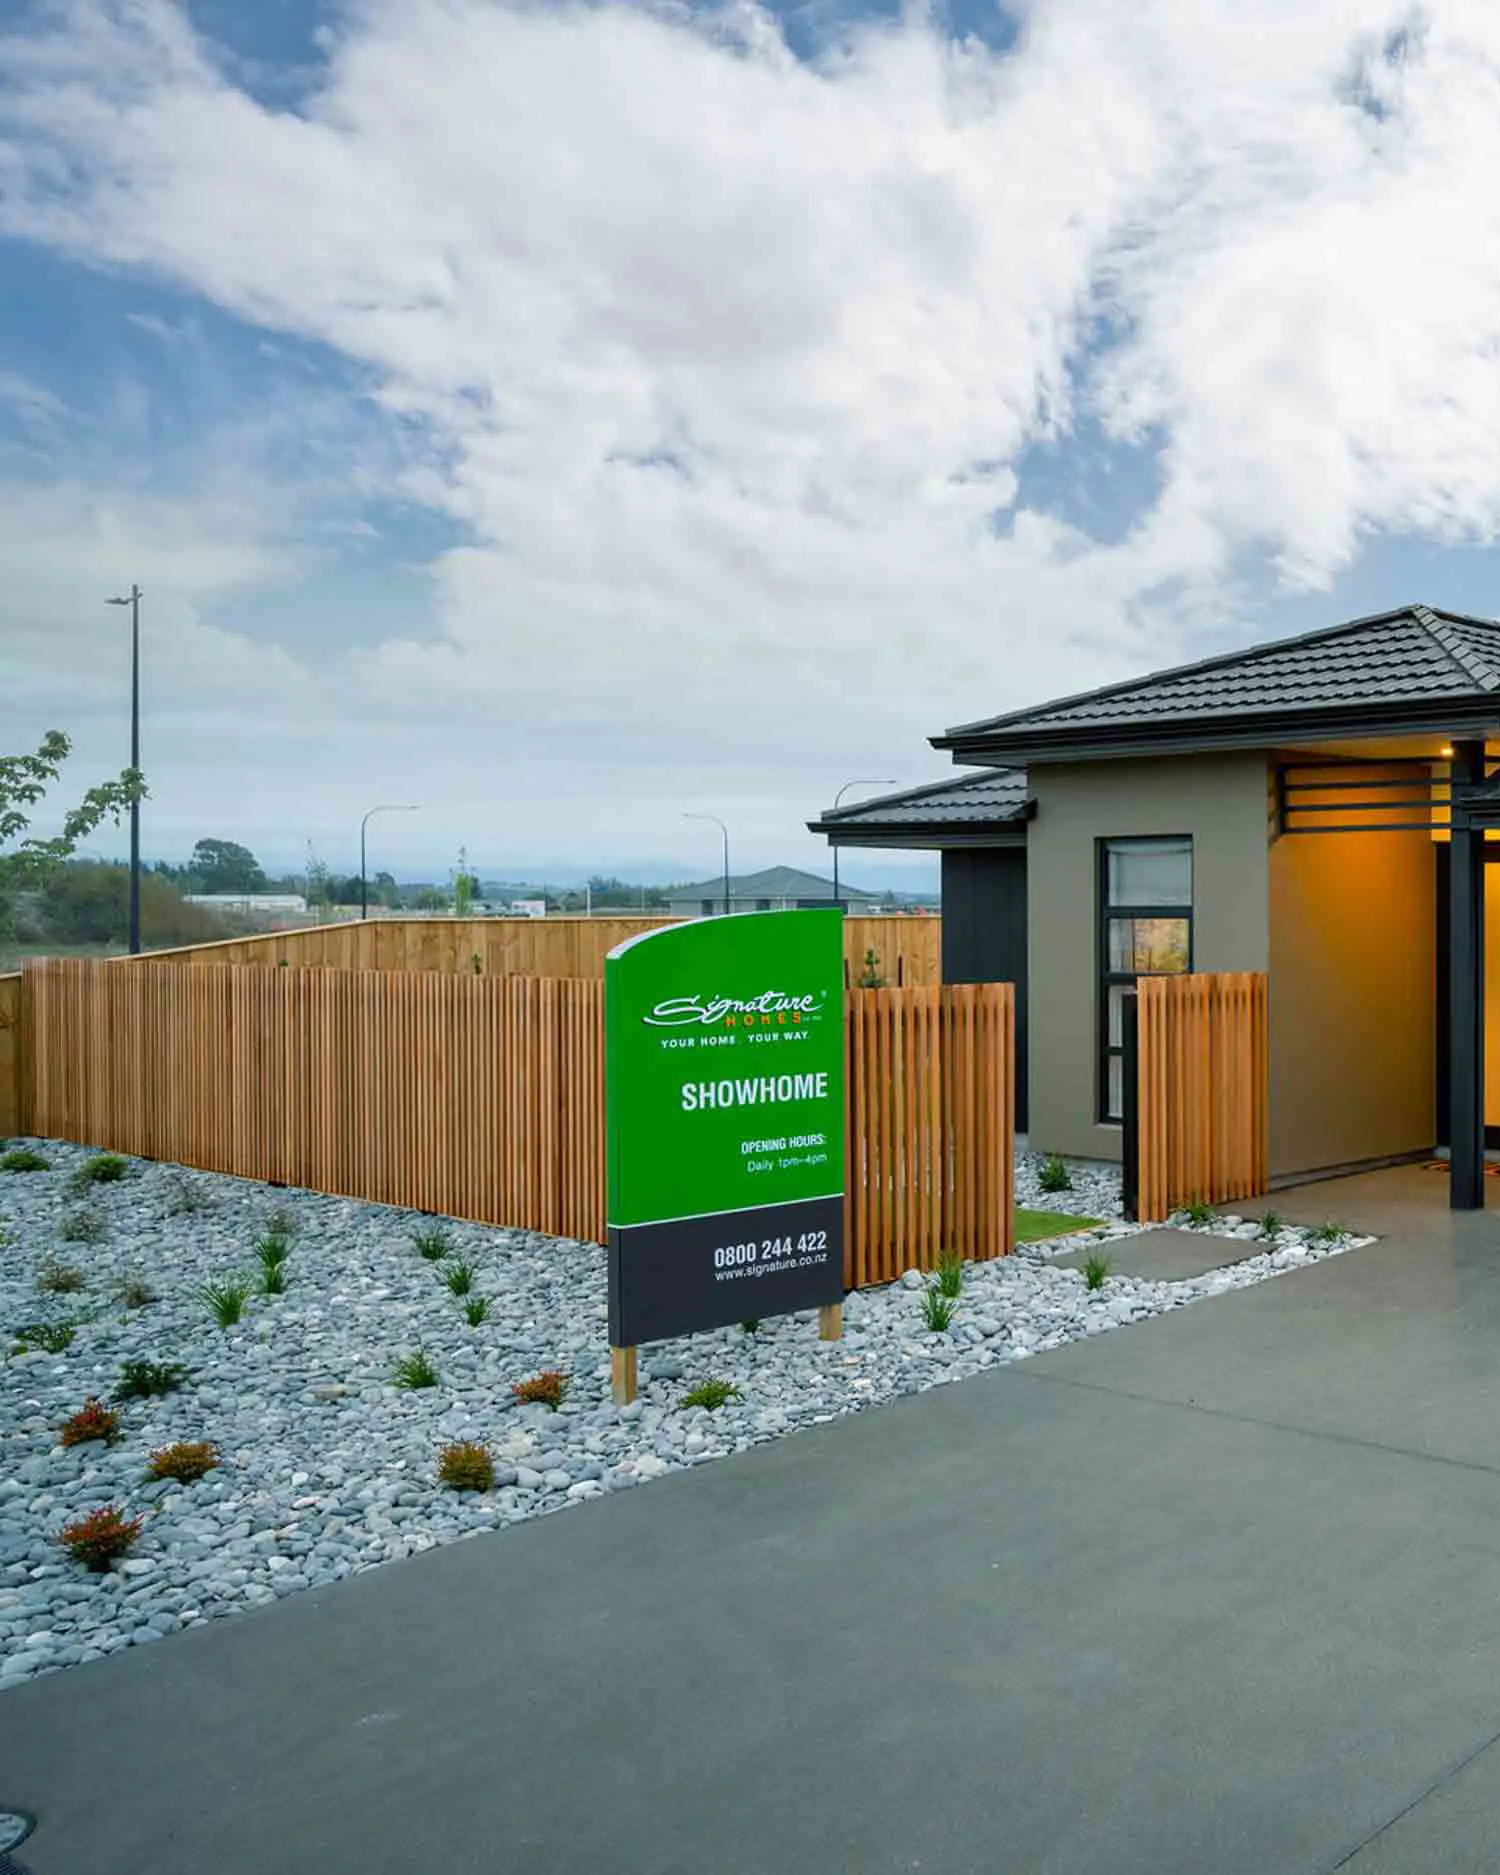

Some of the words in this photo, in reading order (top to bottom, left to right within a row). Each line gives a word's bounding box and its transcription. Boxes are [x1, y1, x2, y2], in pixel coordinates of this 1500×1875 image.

[642, 990, 824, 1026] Signature
[725, 1011, 801, 1027] HOMES
[661, 1037, 695, 1049] YOUR
[748, 1031, 780, 1043] YOUR
[682, 1072, 828, 1110] SHOWHOME
[741, 1137, 786, 1154] OPENING
[747, 1159, 773, 1172] Daily
[714, 1242, 757, 1269] 0800
[761, 1236, 793, 1260] 244
[797, 1230, 827, 1253] 422
[715, 1252, 828, 1281] www.signature.co.nz
